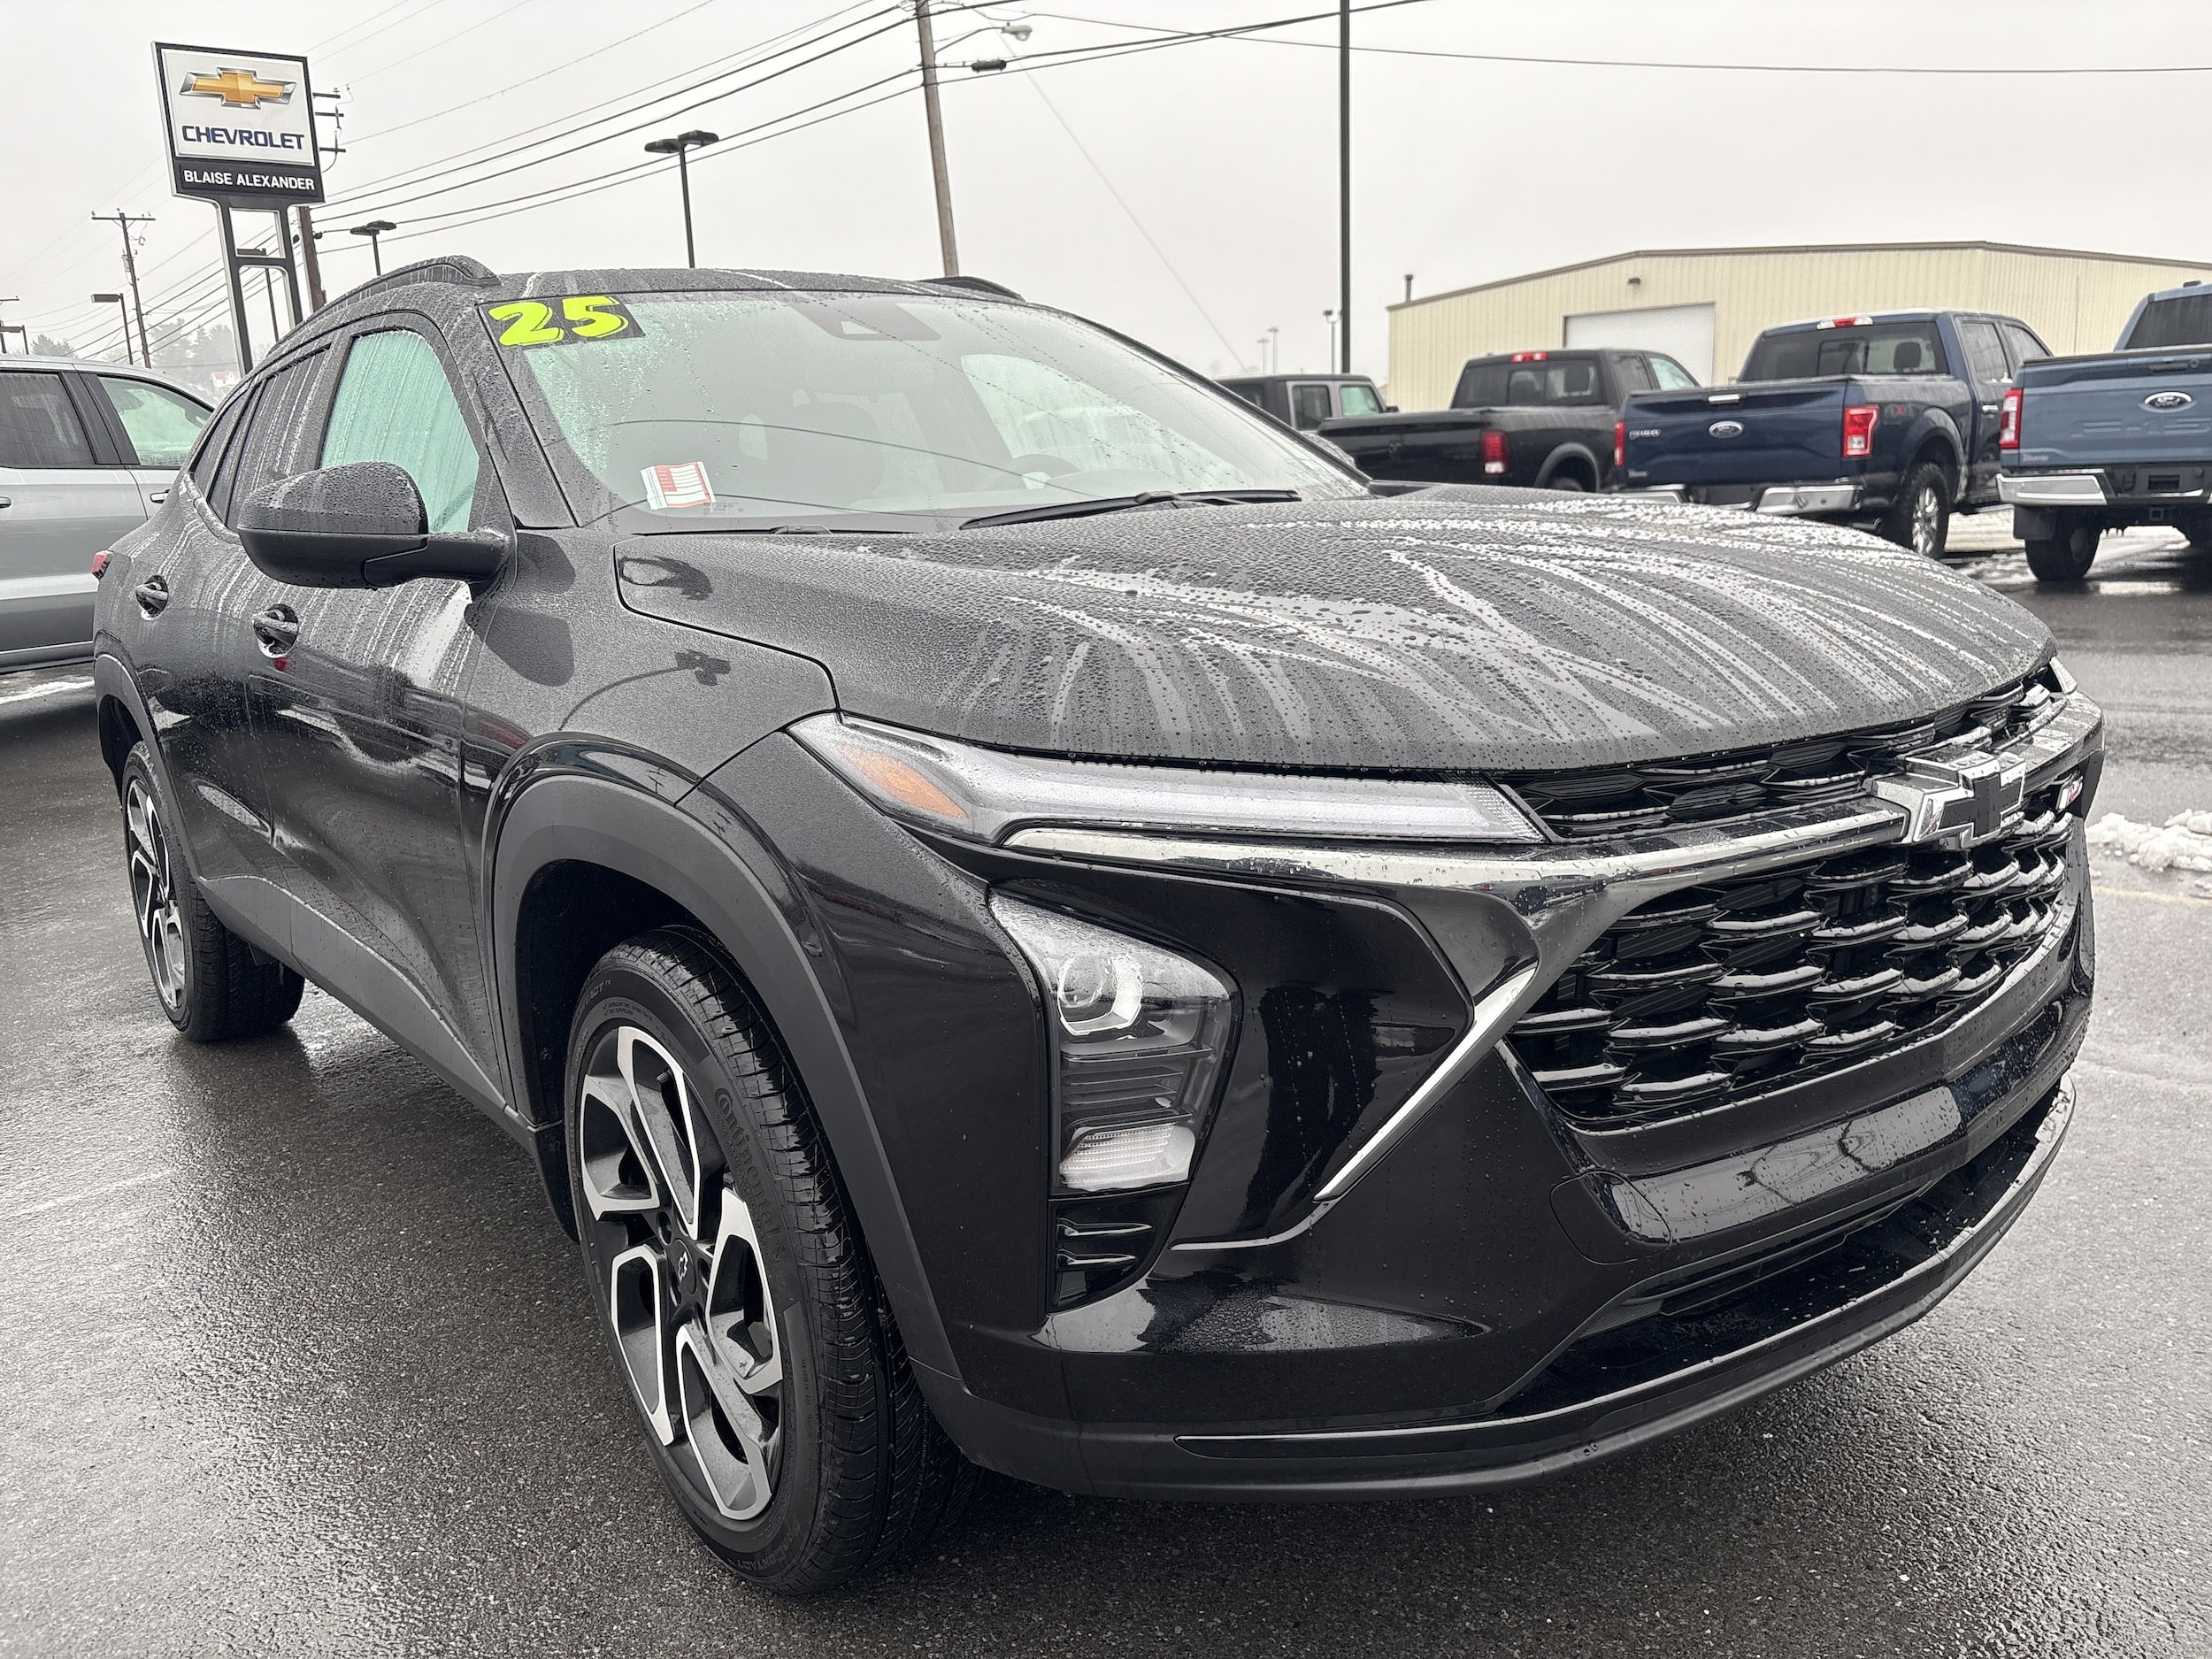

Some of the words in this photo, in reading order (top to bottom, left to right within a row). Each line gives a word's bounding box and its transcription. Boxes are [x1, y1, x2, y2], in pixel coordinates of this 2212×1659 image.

[181, 125, 304, 150] CHEVROLET
[184, 170, 233, 185] BLAISE
[236, 173, 315, 190] ALEXANDER
[488, 296, 629, 346] 25
[714, 1087, 780, 1236] Continental
